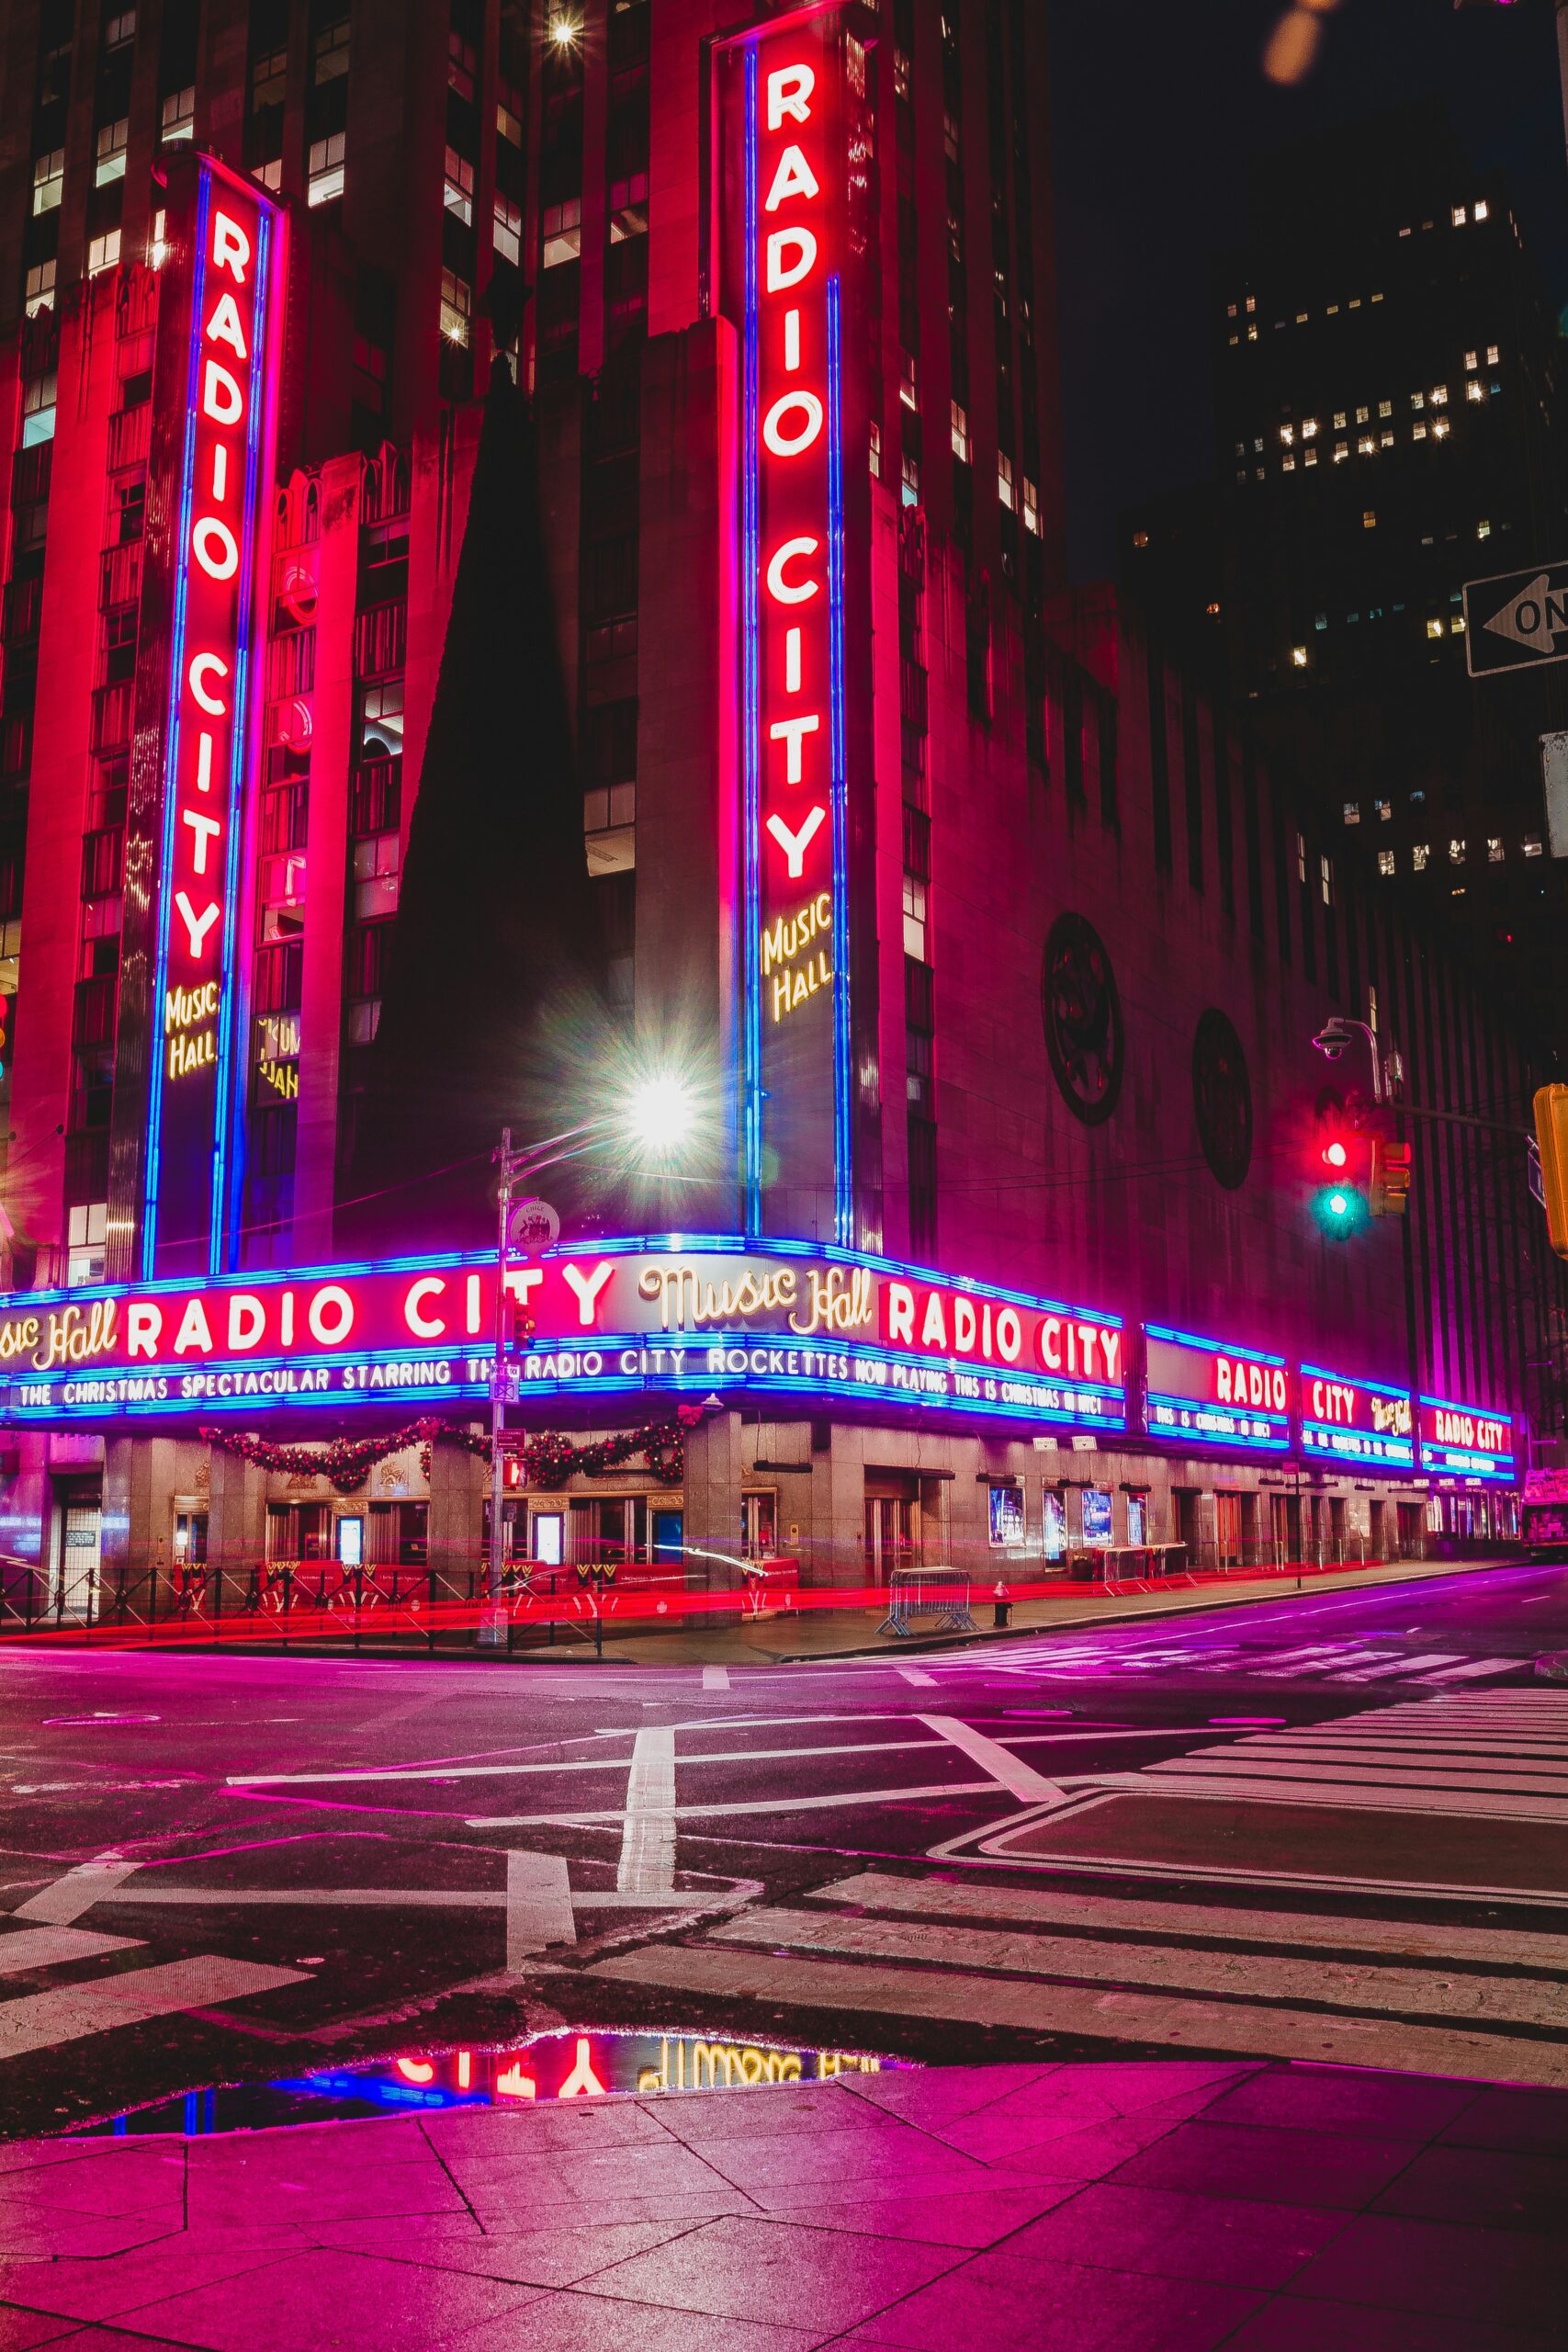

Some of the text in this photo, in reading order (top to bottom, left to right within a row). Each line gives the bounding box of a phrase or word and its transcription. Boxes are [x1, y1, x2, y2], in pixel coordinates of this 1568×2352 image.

[763, 63, 826, 879] RADIO CITY
[175, 210, 250, 958] RADIO CITY
[763, 892, 831, 976] MUSIC
[165, 982, 217, 1035] MUSIC
[773, 950, 831, 1024] HALL
[170, 1031, 214, 1080] HALL
[32, 1297, 118, 1371] Hall
[128, 1261, 874, 1358] RADIO CITY Music Hall
[888, 1282, 1119, 1379] RADIO CITY
[20, 1349, 848, 1407] THE CHRISTMAS SPECTACULAR STARRING TH RADIO CITY ROCKETTES
[855, 1359, 887, 1385] NOW
[893, 1363, 947, 1393] PLAYING
[953, 1374, 980, 1398] THIS
[985, 1378, 997, 1400] IS
[1001, 1382, 1060, 1409] CHRISTMAS
[1216, 1357, 1286, 1410] RADIO
[1312, 1380, 1354, 1423] CITY
[1435, 1409, 1475, 1447] RADIO
[1477, 1419, 1504, 1451] CITY
